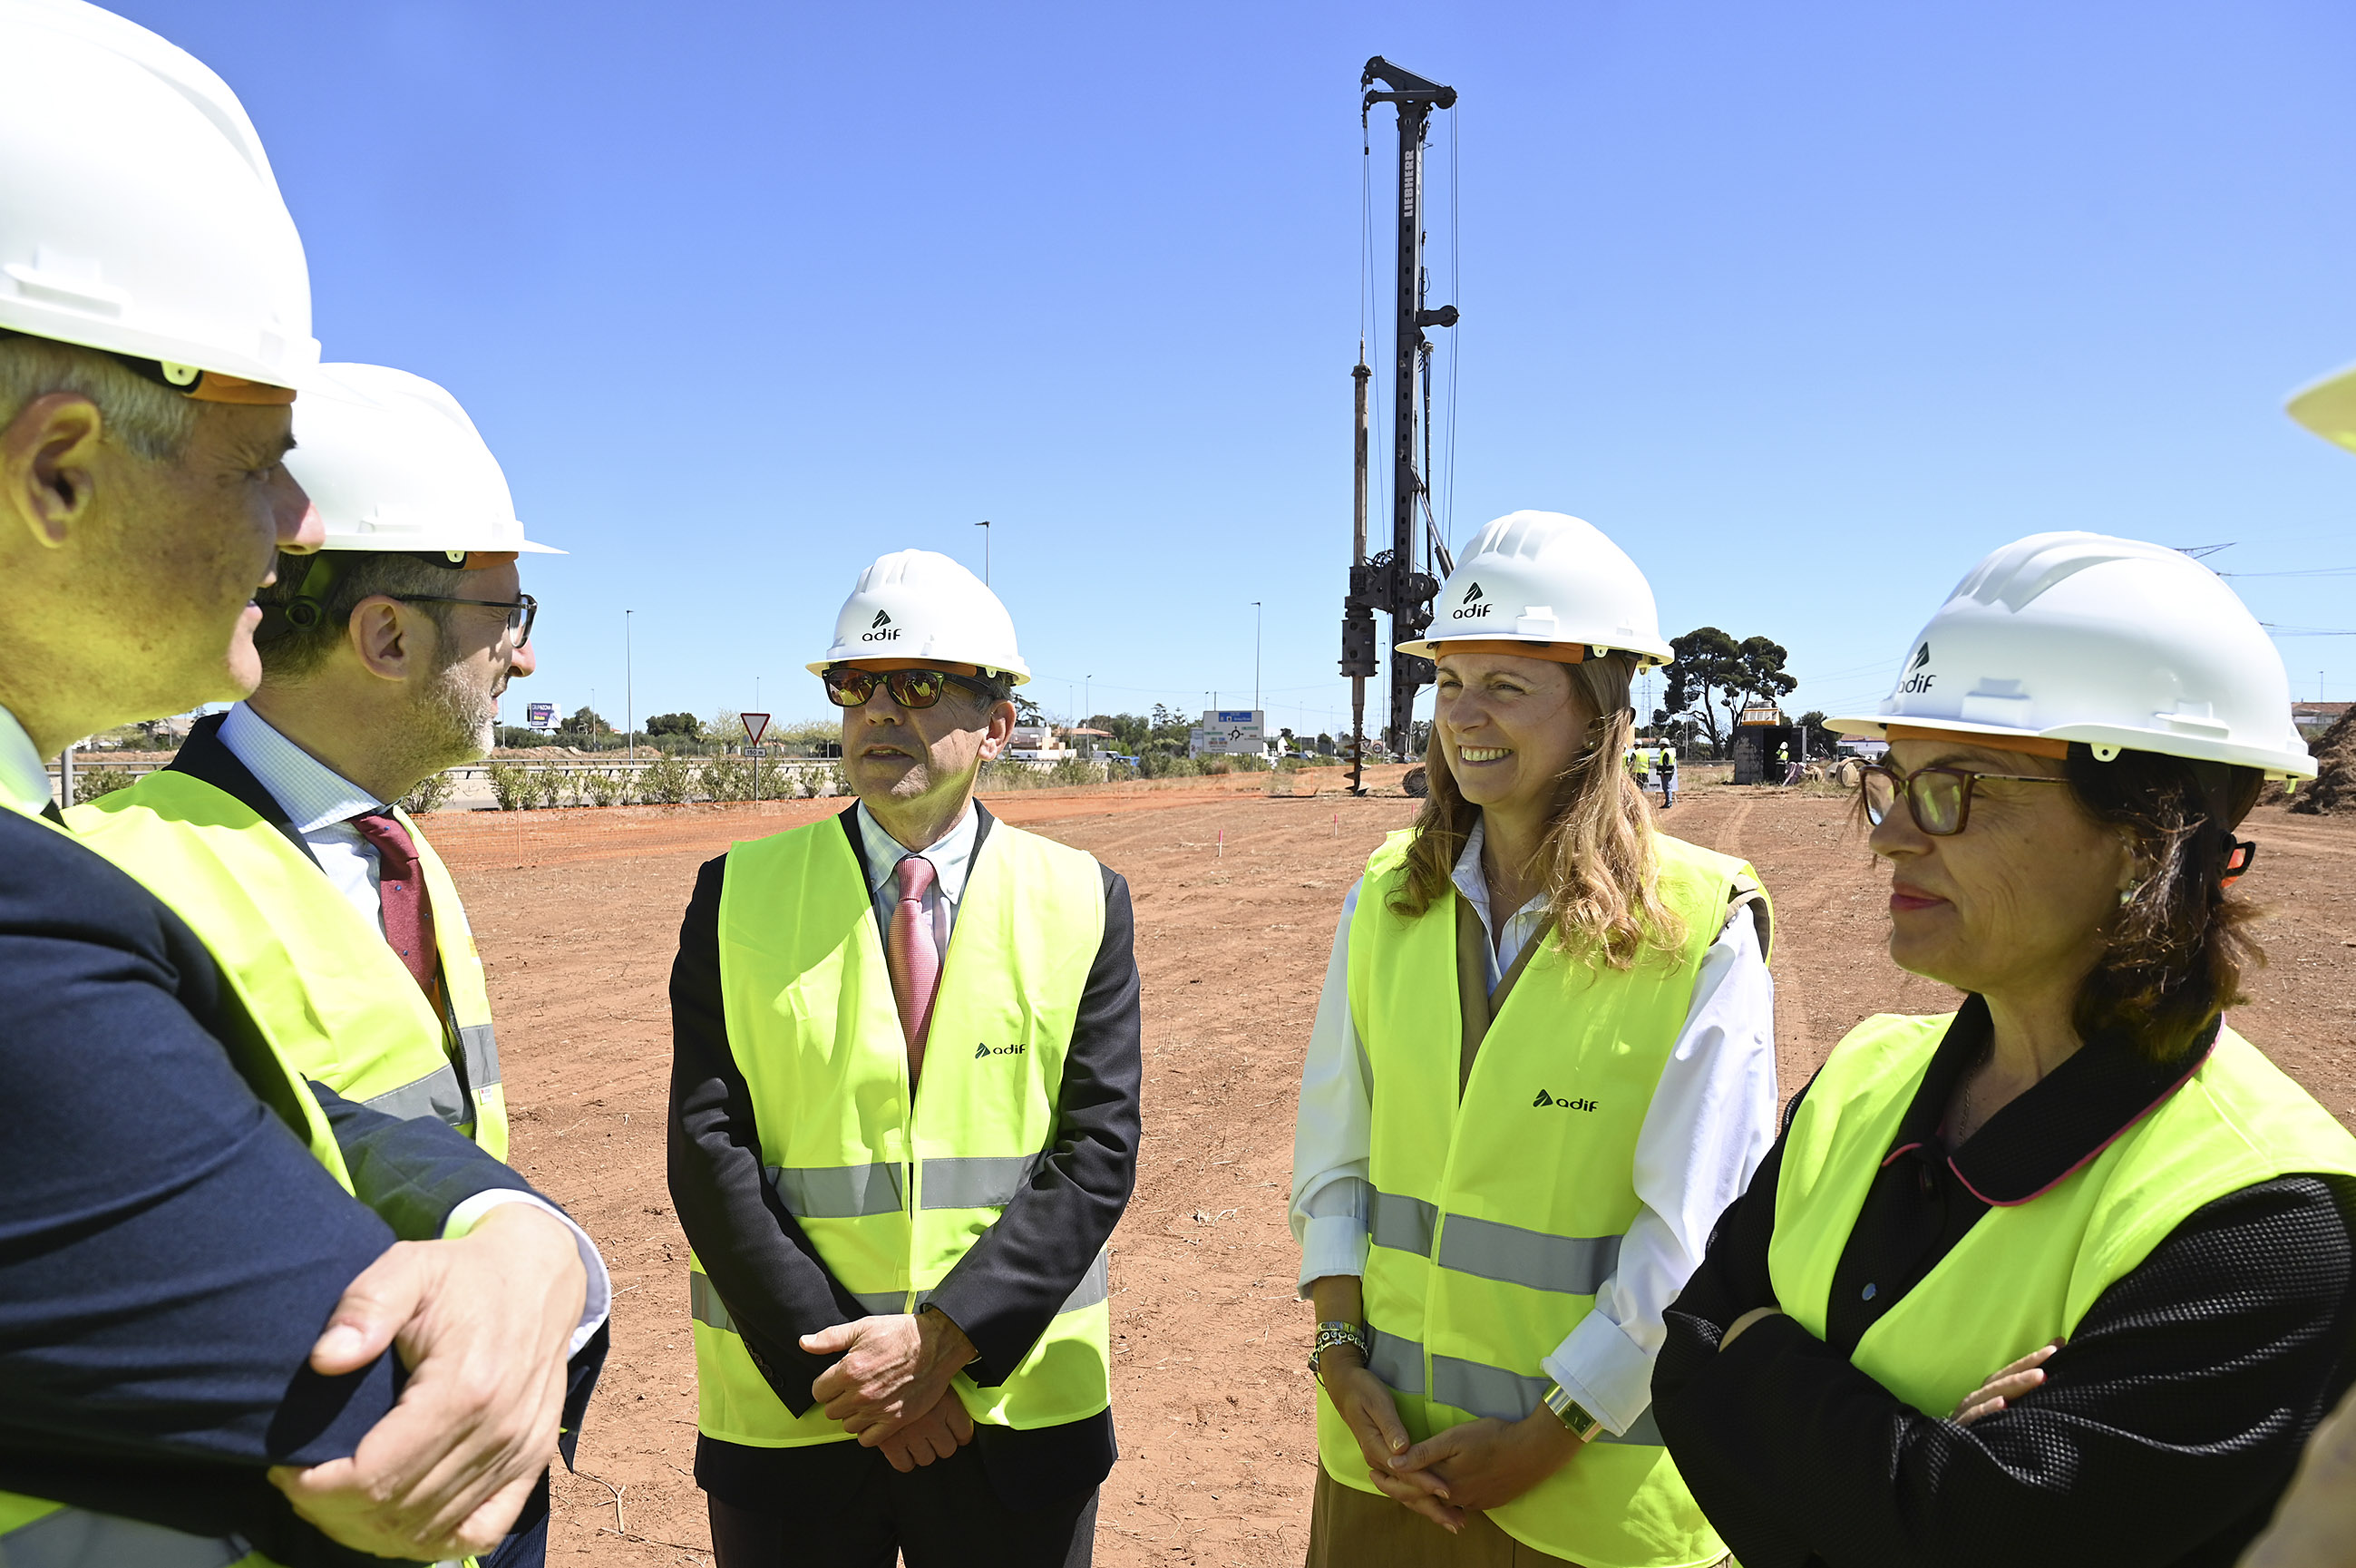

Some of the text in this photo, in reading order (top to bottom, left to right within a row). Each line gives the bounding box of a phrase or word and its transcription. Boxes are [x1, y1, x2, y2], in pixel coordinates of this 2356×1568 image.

[1404, 150, 1414, 217] LIEBHERR
[1452, 603, 1494, 619] adif
[862, 628, 902, 642] adif
[1896, 673, 1937, 694] adif
[992, 1043, 1027, 1055] adif
[1555, 1097, 1599, 1113] adif
